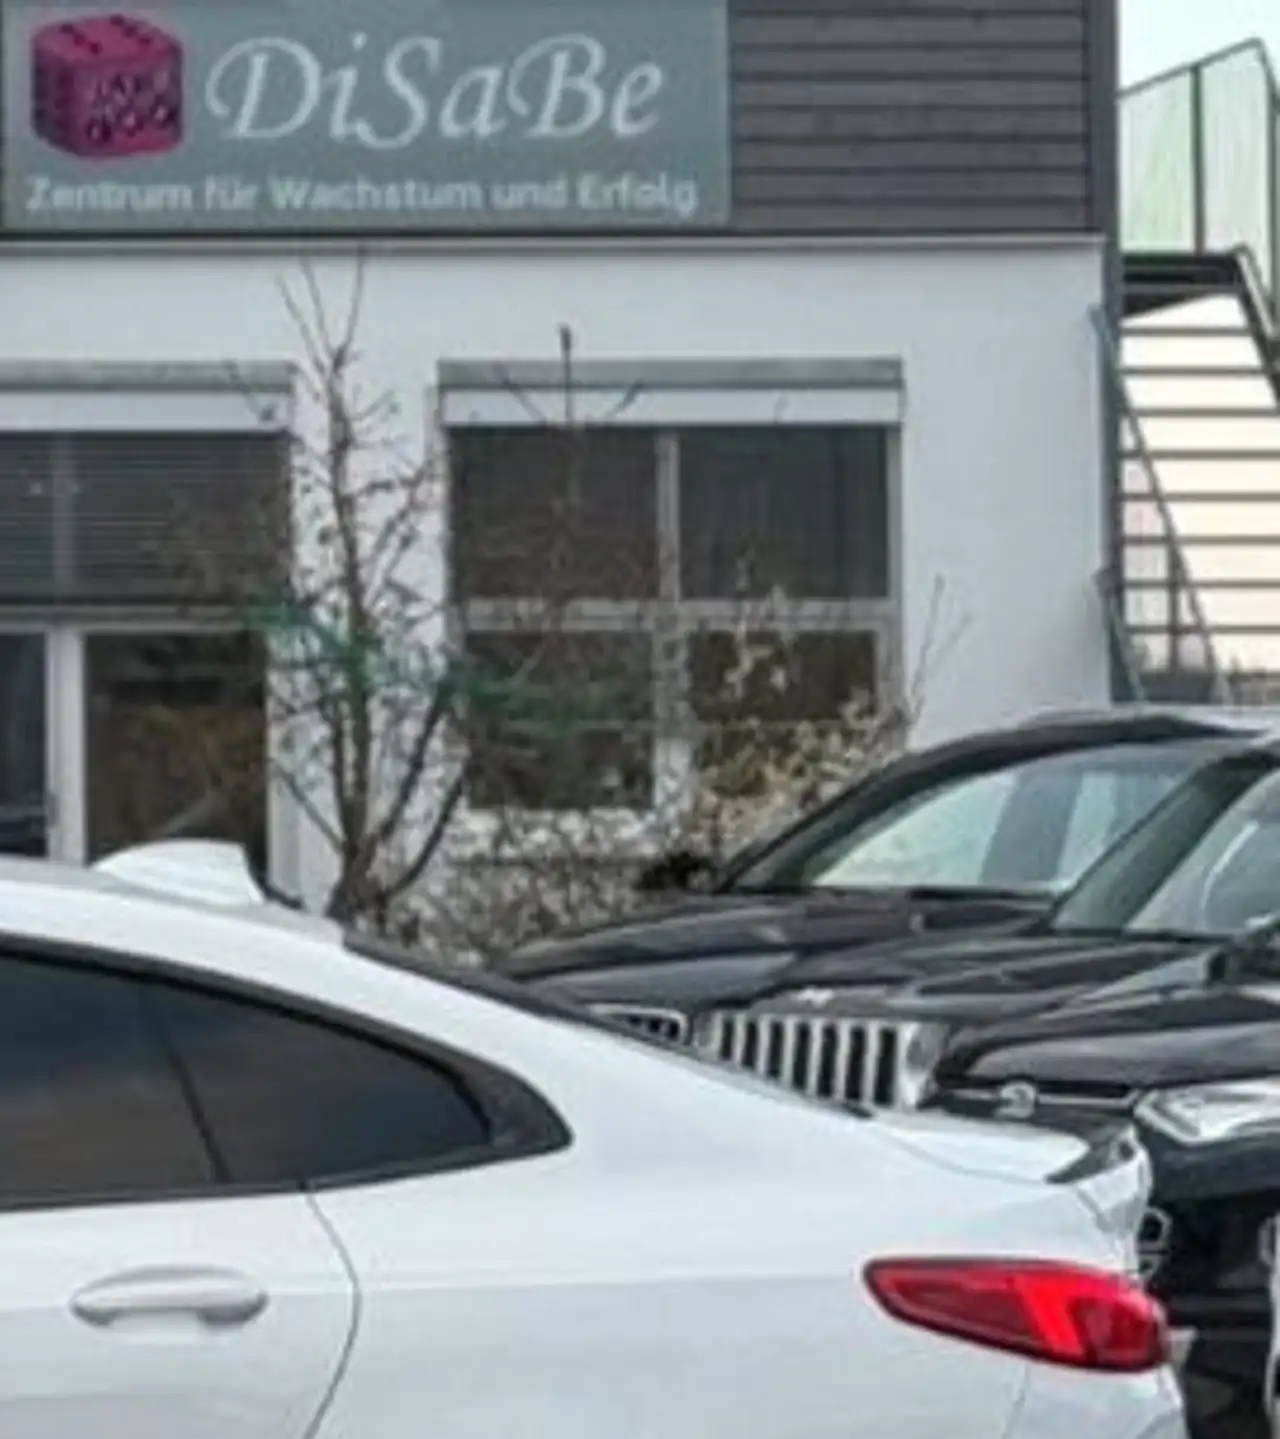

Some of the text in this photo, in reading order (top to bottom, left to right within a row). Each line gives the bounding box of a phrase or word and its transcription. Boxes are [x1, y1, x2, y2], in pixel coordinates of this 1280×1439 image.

[204, 31, 663, 149] DiSaBe
[25, 171, 698, 218] Zentrum für Wachstum und Erfolg
